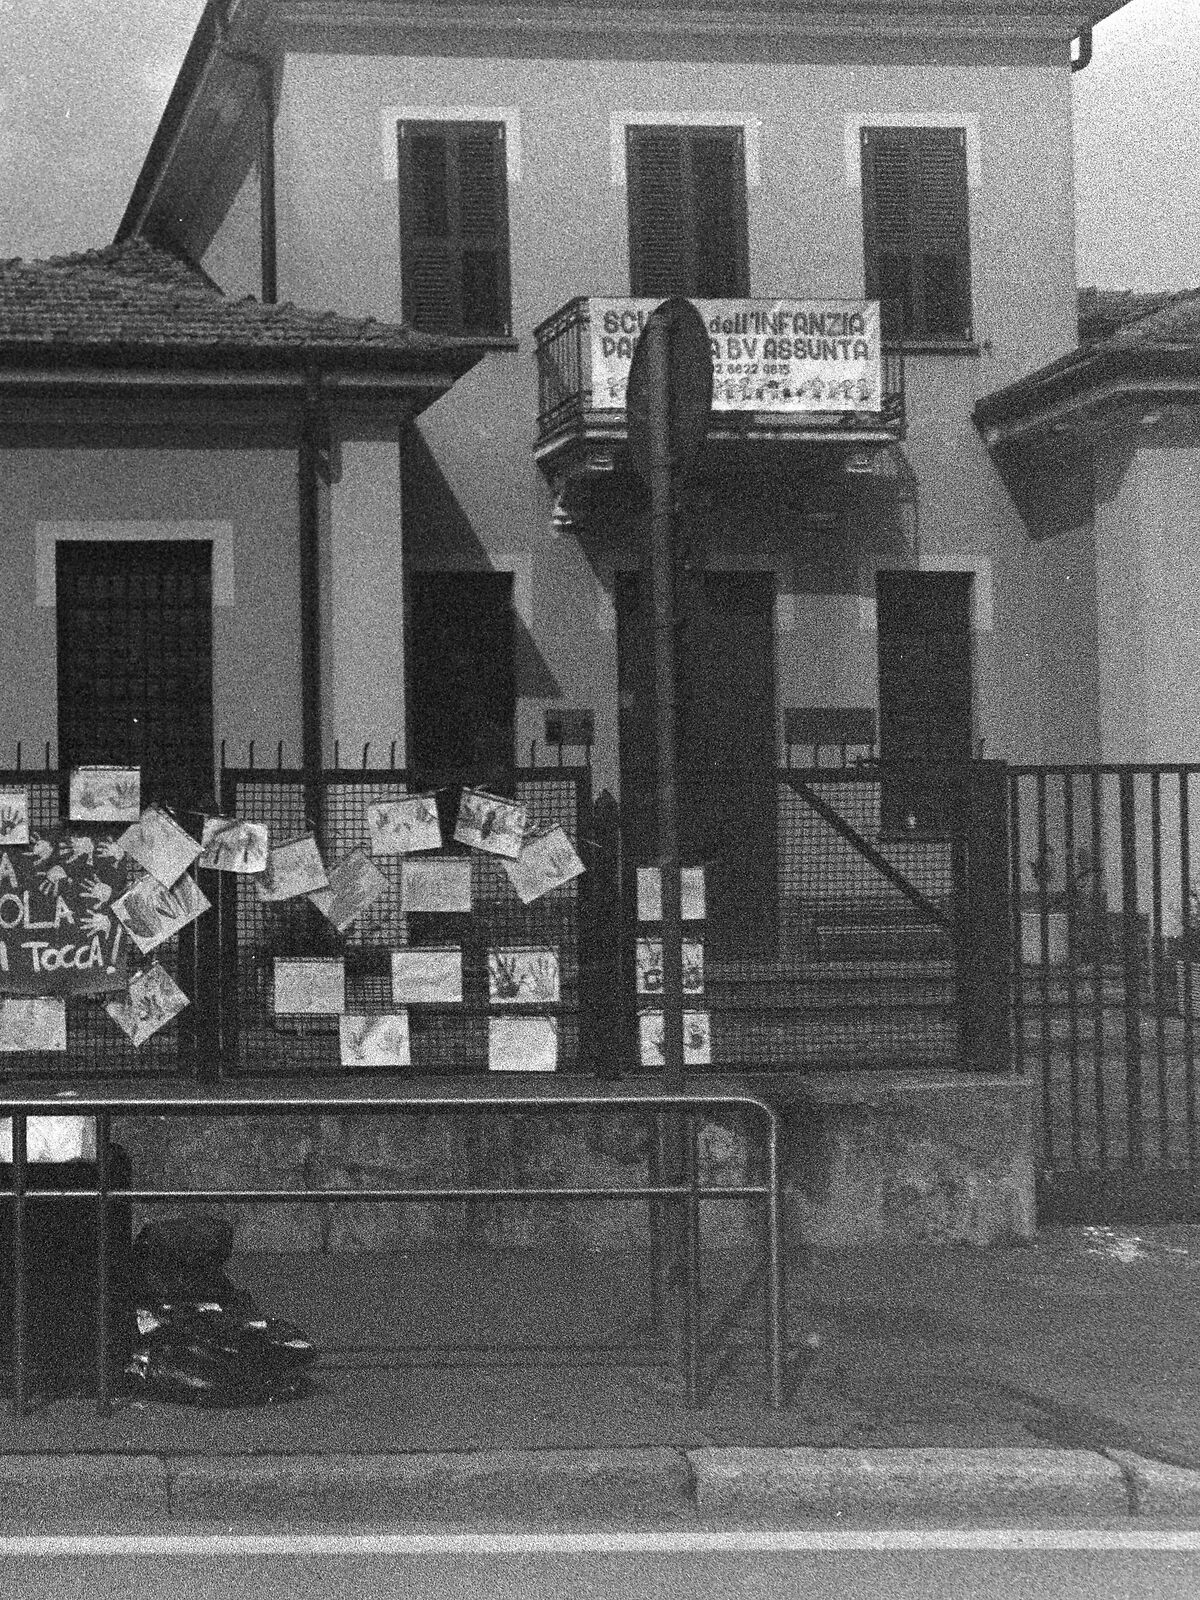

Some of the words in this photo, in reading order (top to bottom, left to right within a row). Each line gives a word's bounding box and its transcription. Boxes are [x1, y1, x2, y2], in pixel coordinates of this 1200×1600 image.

[709, 311, 866, 336] dell'INFANZIA
[727, 338, 757, 361] BV
[763, 338, 870, 361] ASSUNTA
